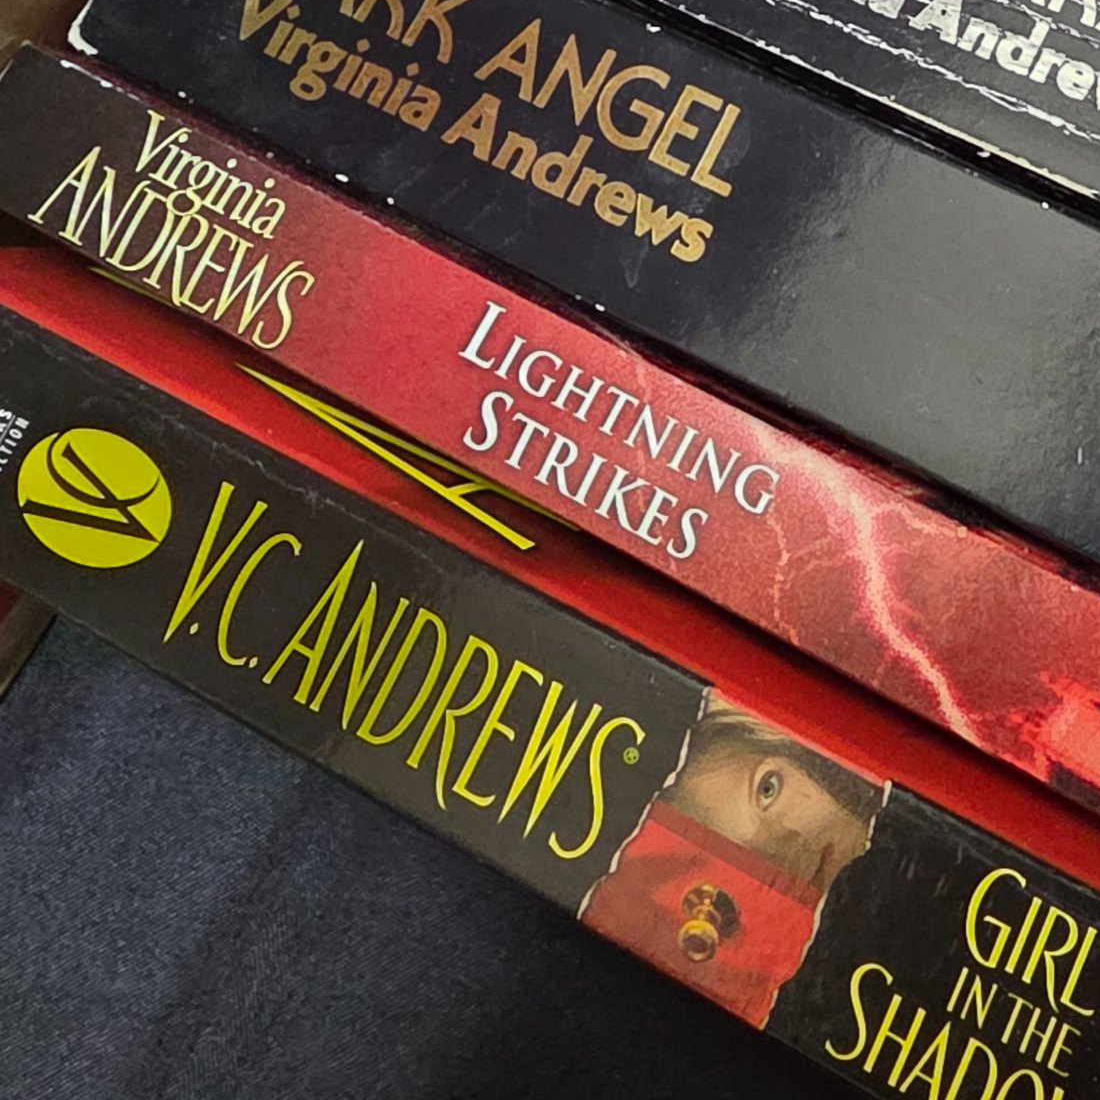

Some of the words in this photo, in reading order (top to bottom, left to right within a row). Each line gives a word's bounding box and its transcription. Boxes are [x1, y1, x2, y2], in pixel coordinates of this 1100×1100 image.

[130, 109, 286, 239] Virginia
[442, 92, 714, 263] Andrews
[473, 18, 741, 197] ANGEL
[28, 145, 314, 351] ANDREWS
[458, 300, 781, 516] LIGHTNING
[461, 391, 709, 561] STRIKES
[163, 481, 302, 670] V.C.
[946, 966, 998, 1029] IN
[1000, 992, 1081, 1077] THE
[965, 867, 1098, 1016] GIRL
[825, 963, 1064, 1100] SHAD
